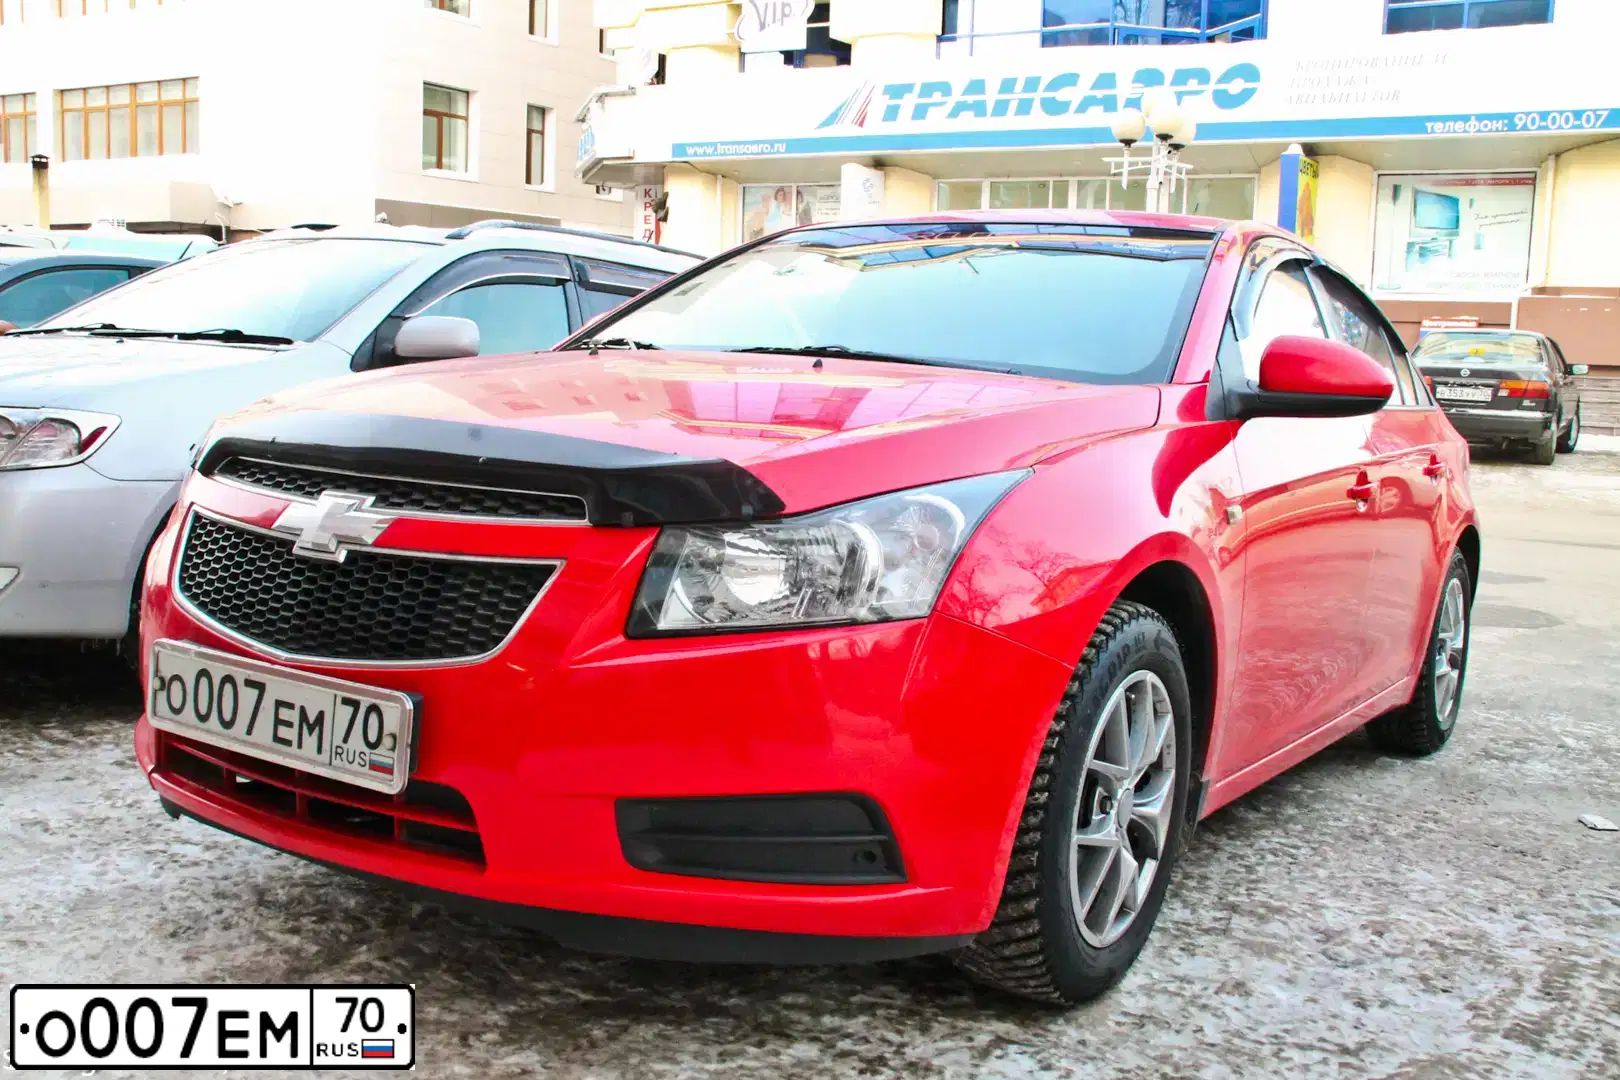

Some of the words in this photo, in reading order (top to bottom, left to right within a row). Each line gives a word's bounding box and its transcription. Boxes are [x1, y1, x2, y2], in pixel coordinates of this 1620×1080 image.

[1424, 116, 1509, 134] телефон:
[1513, 110, 1610, 131] 90-00-07
[685, 142, 787, 156] www.transaero.ru
[340, 697, 385, 751] 70
[334, 744, 368, 769] RUS
